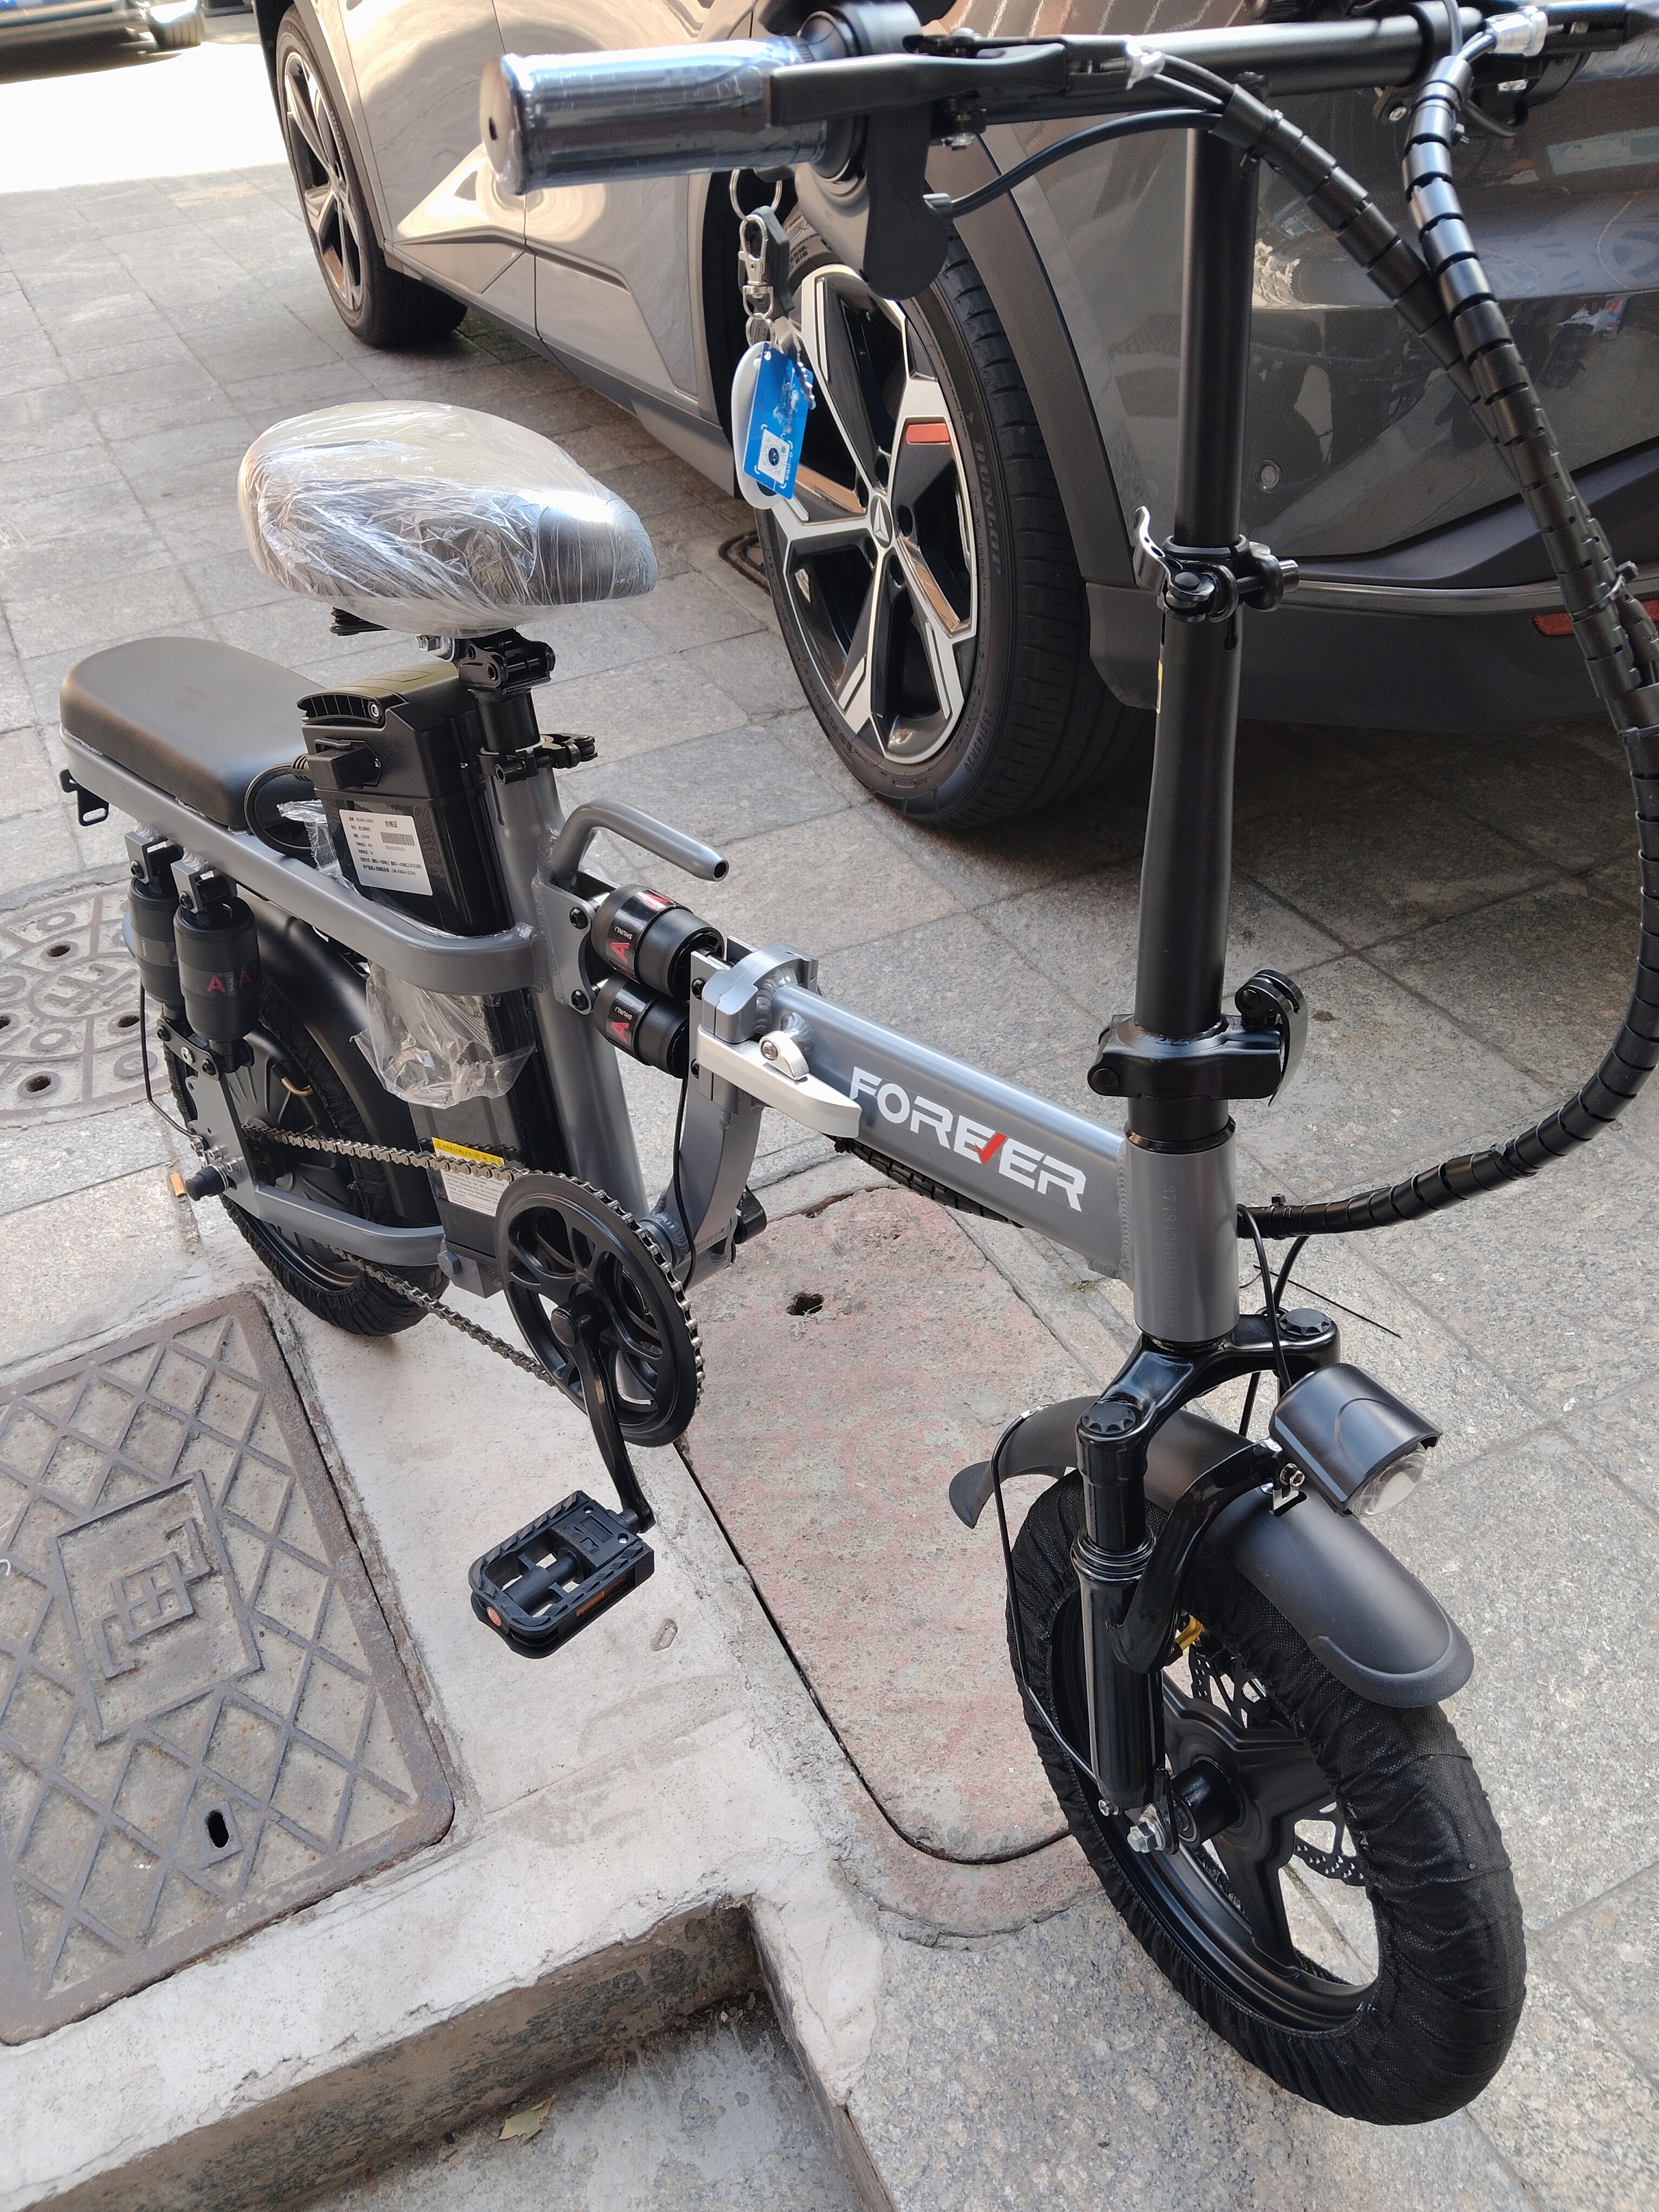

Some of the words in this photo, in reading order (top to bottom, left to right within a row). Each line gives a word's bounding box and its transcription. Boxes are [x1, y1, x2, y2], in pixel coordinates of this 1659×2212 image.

[974, 441, 1001, 575] DUNLOP
[614, 926, 633, 940] SHUNLI
[207, 976, 226, 993] A
[614, 1006, 633, 1020] SHUNLI
[850, 1066, 1086, 1212] FOREVER
